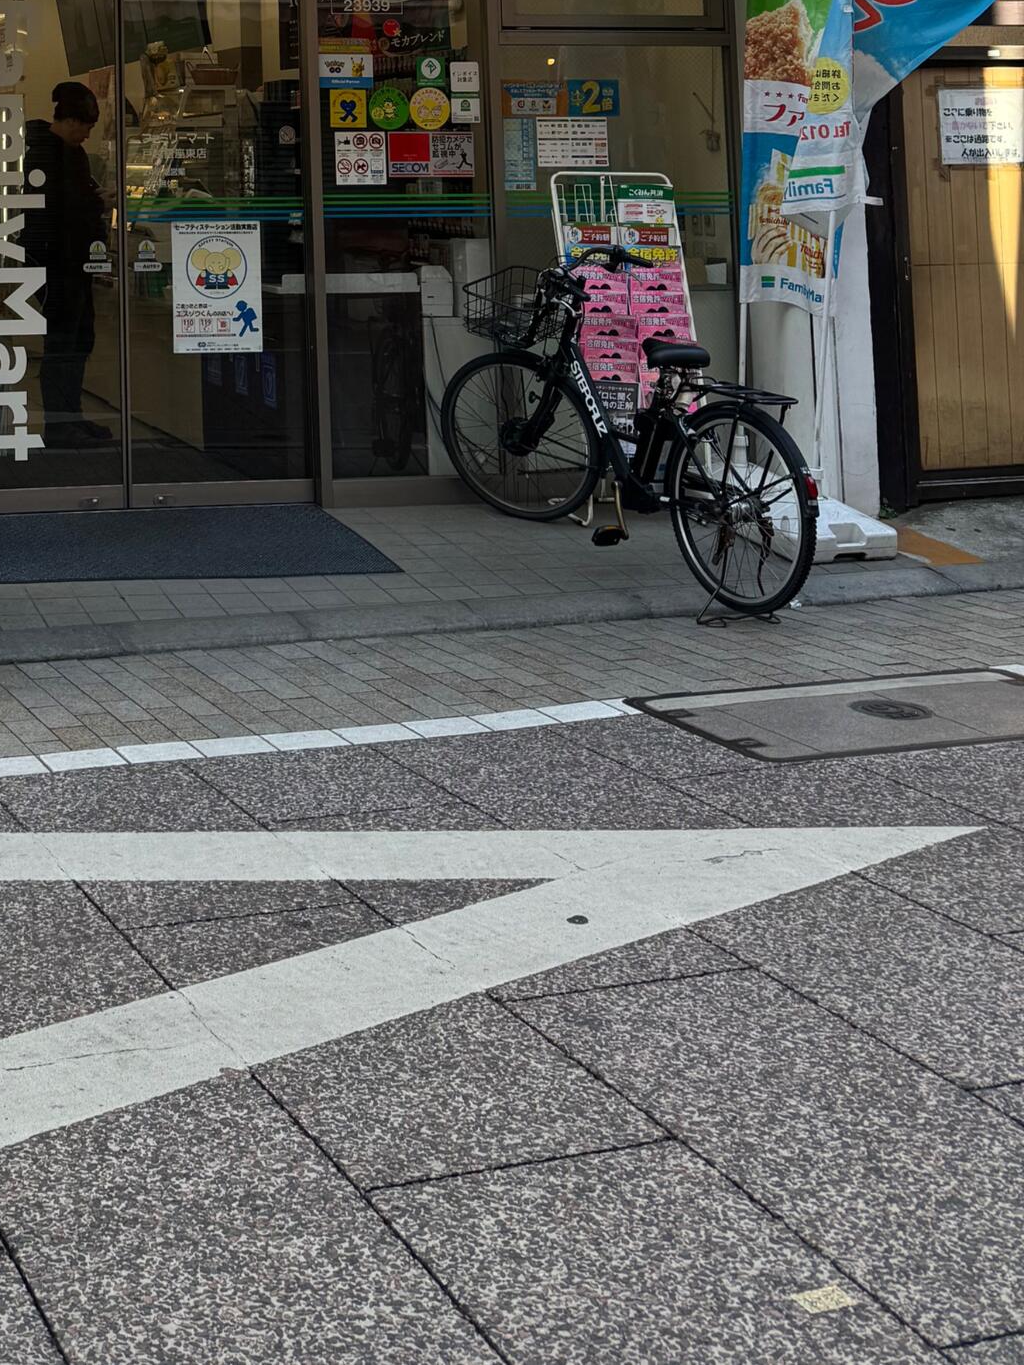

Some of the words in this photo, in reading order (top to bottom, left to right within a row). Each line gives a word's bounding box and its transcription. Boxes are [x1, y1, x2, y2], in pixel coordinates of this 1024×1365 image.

[343, 0, 391, 12] 23939
[390, 29, 445, 48] モカブレンド
[432, 135, 472, 144] 防犯カメラで
[391, 162, 430, 173] SECOM
[209, 274, 225, 284] SS
